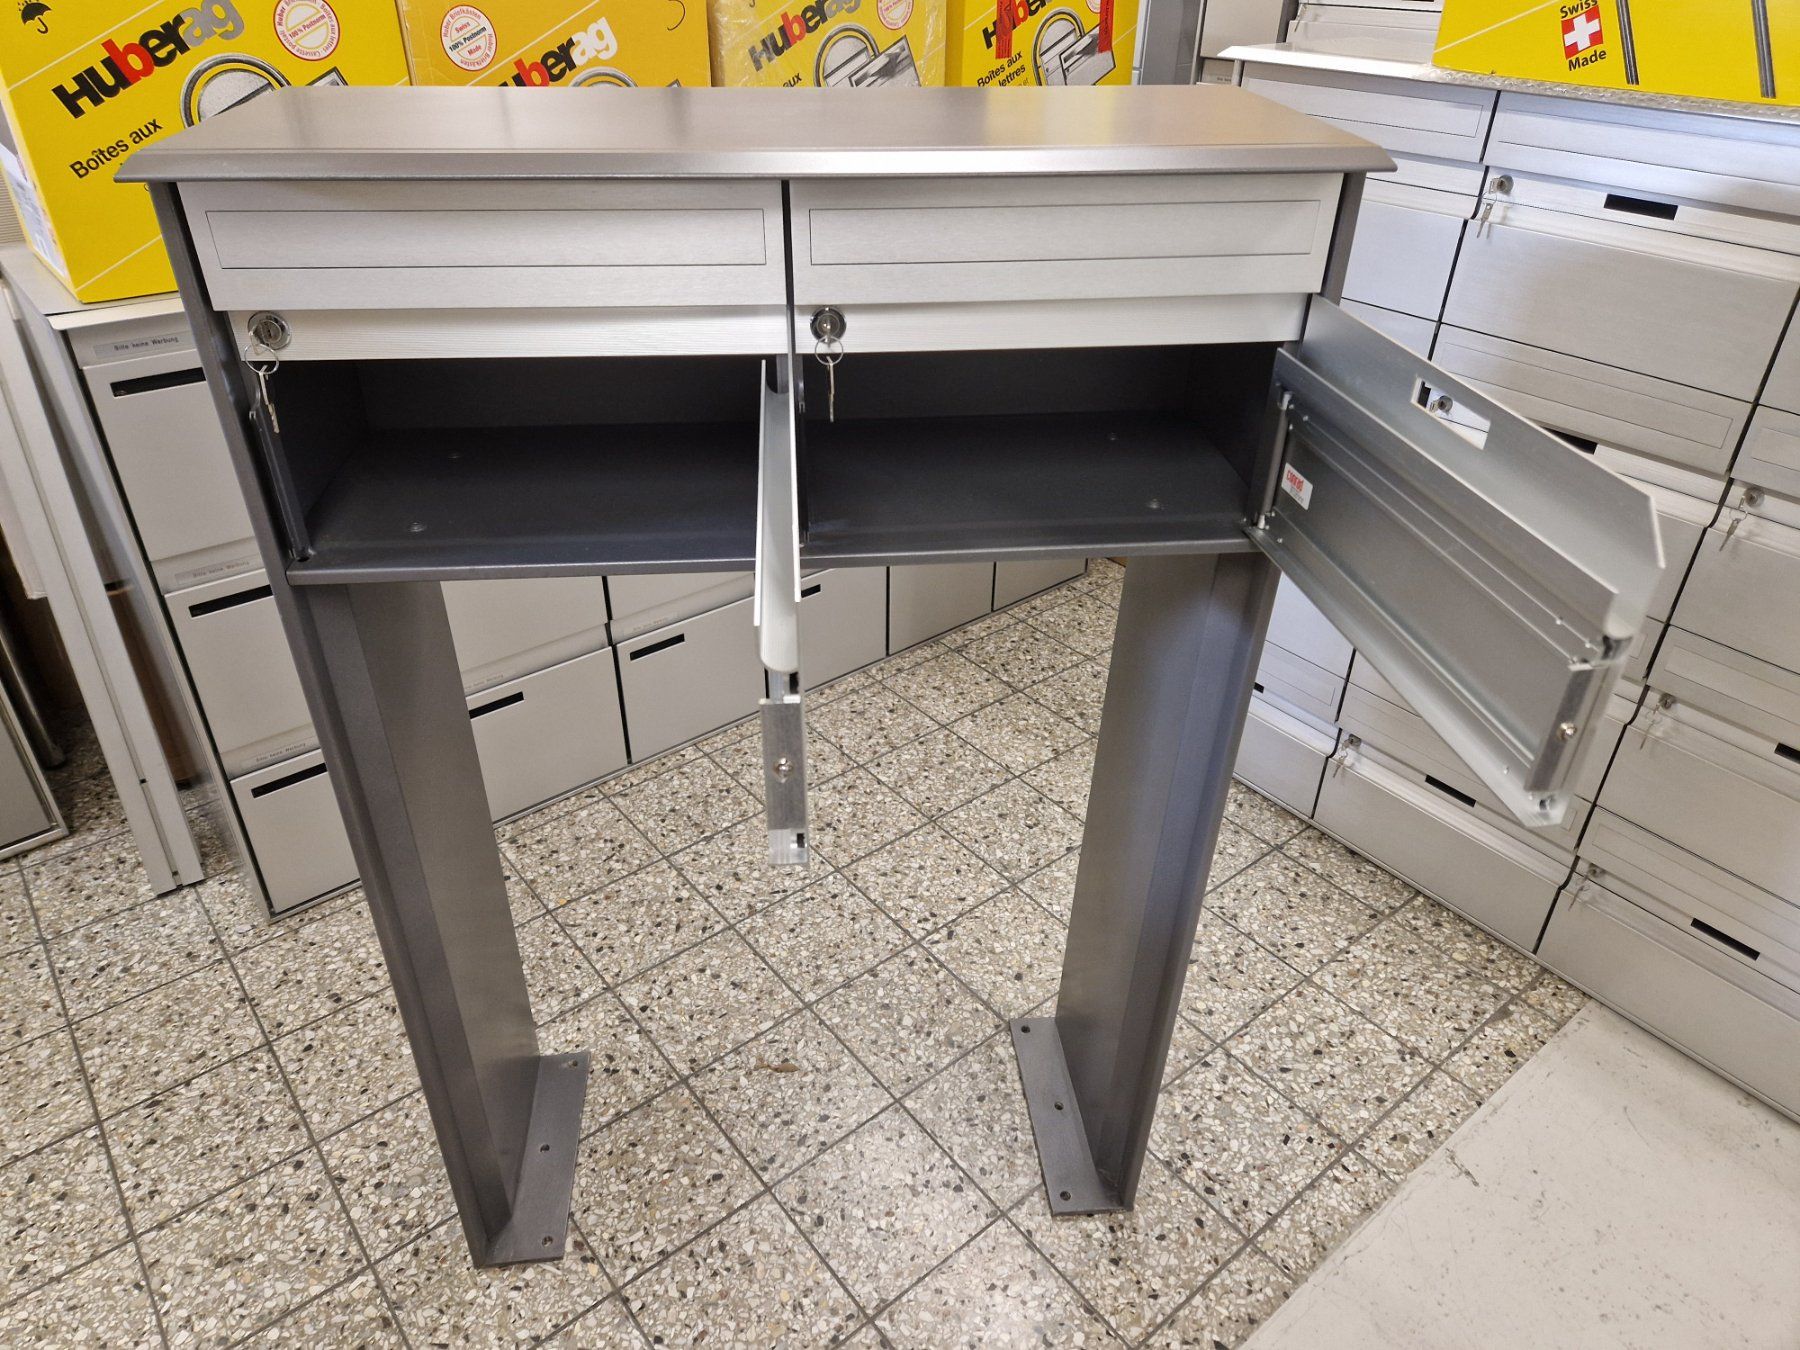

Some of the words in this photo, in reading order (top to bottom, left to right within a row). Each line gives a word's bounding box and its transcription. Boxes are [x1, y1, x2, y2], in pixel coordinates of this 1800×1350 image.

[1560, 0, 1598, 18] Swiss
[449, 41, 463, 52] 100%
[463, 26, 487, 44] Postnorm
[455, 21, 471, 33] Swiss
[51, 0, 244, 119] Huberag
[977, 64, 1005, 87] Boîtes
[1007, 51, 1022, 68] aux
[1568, 50, 1607, 71] Made
[69, 139, 129, 179] Boîtes
[128, 118, 163, 145] aux
